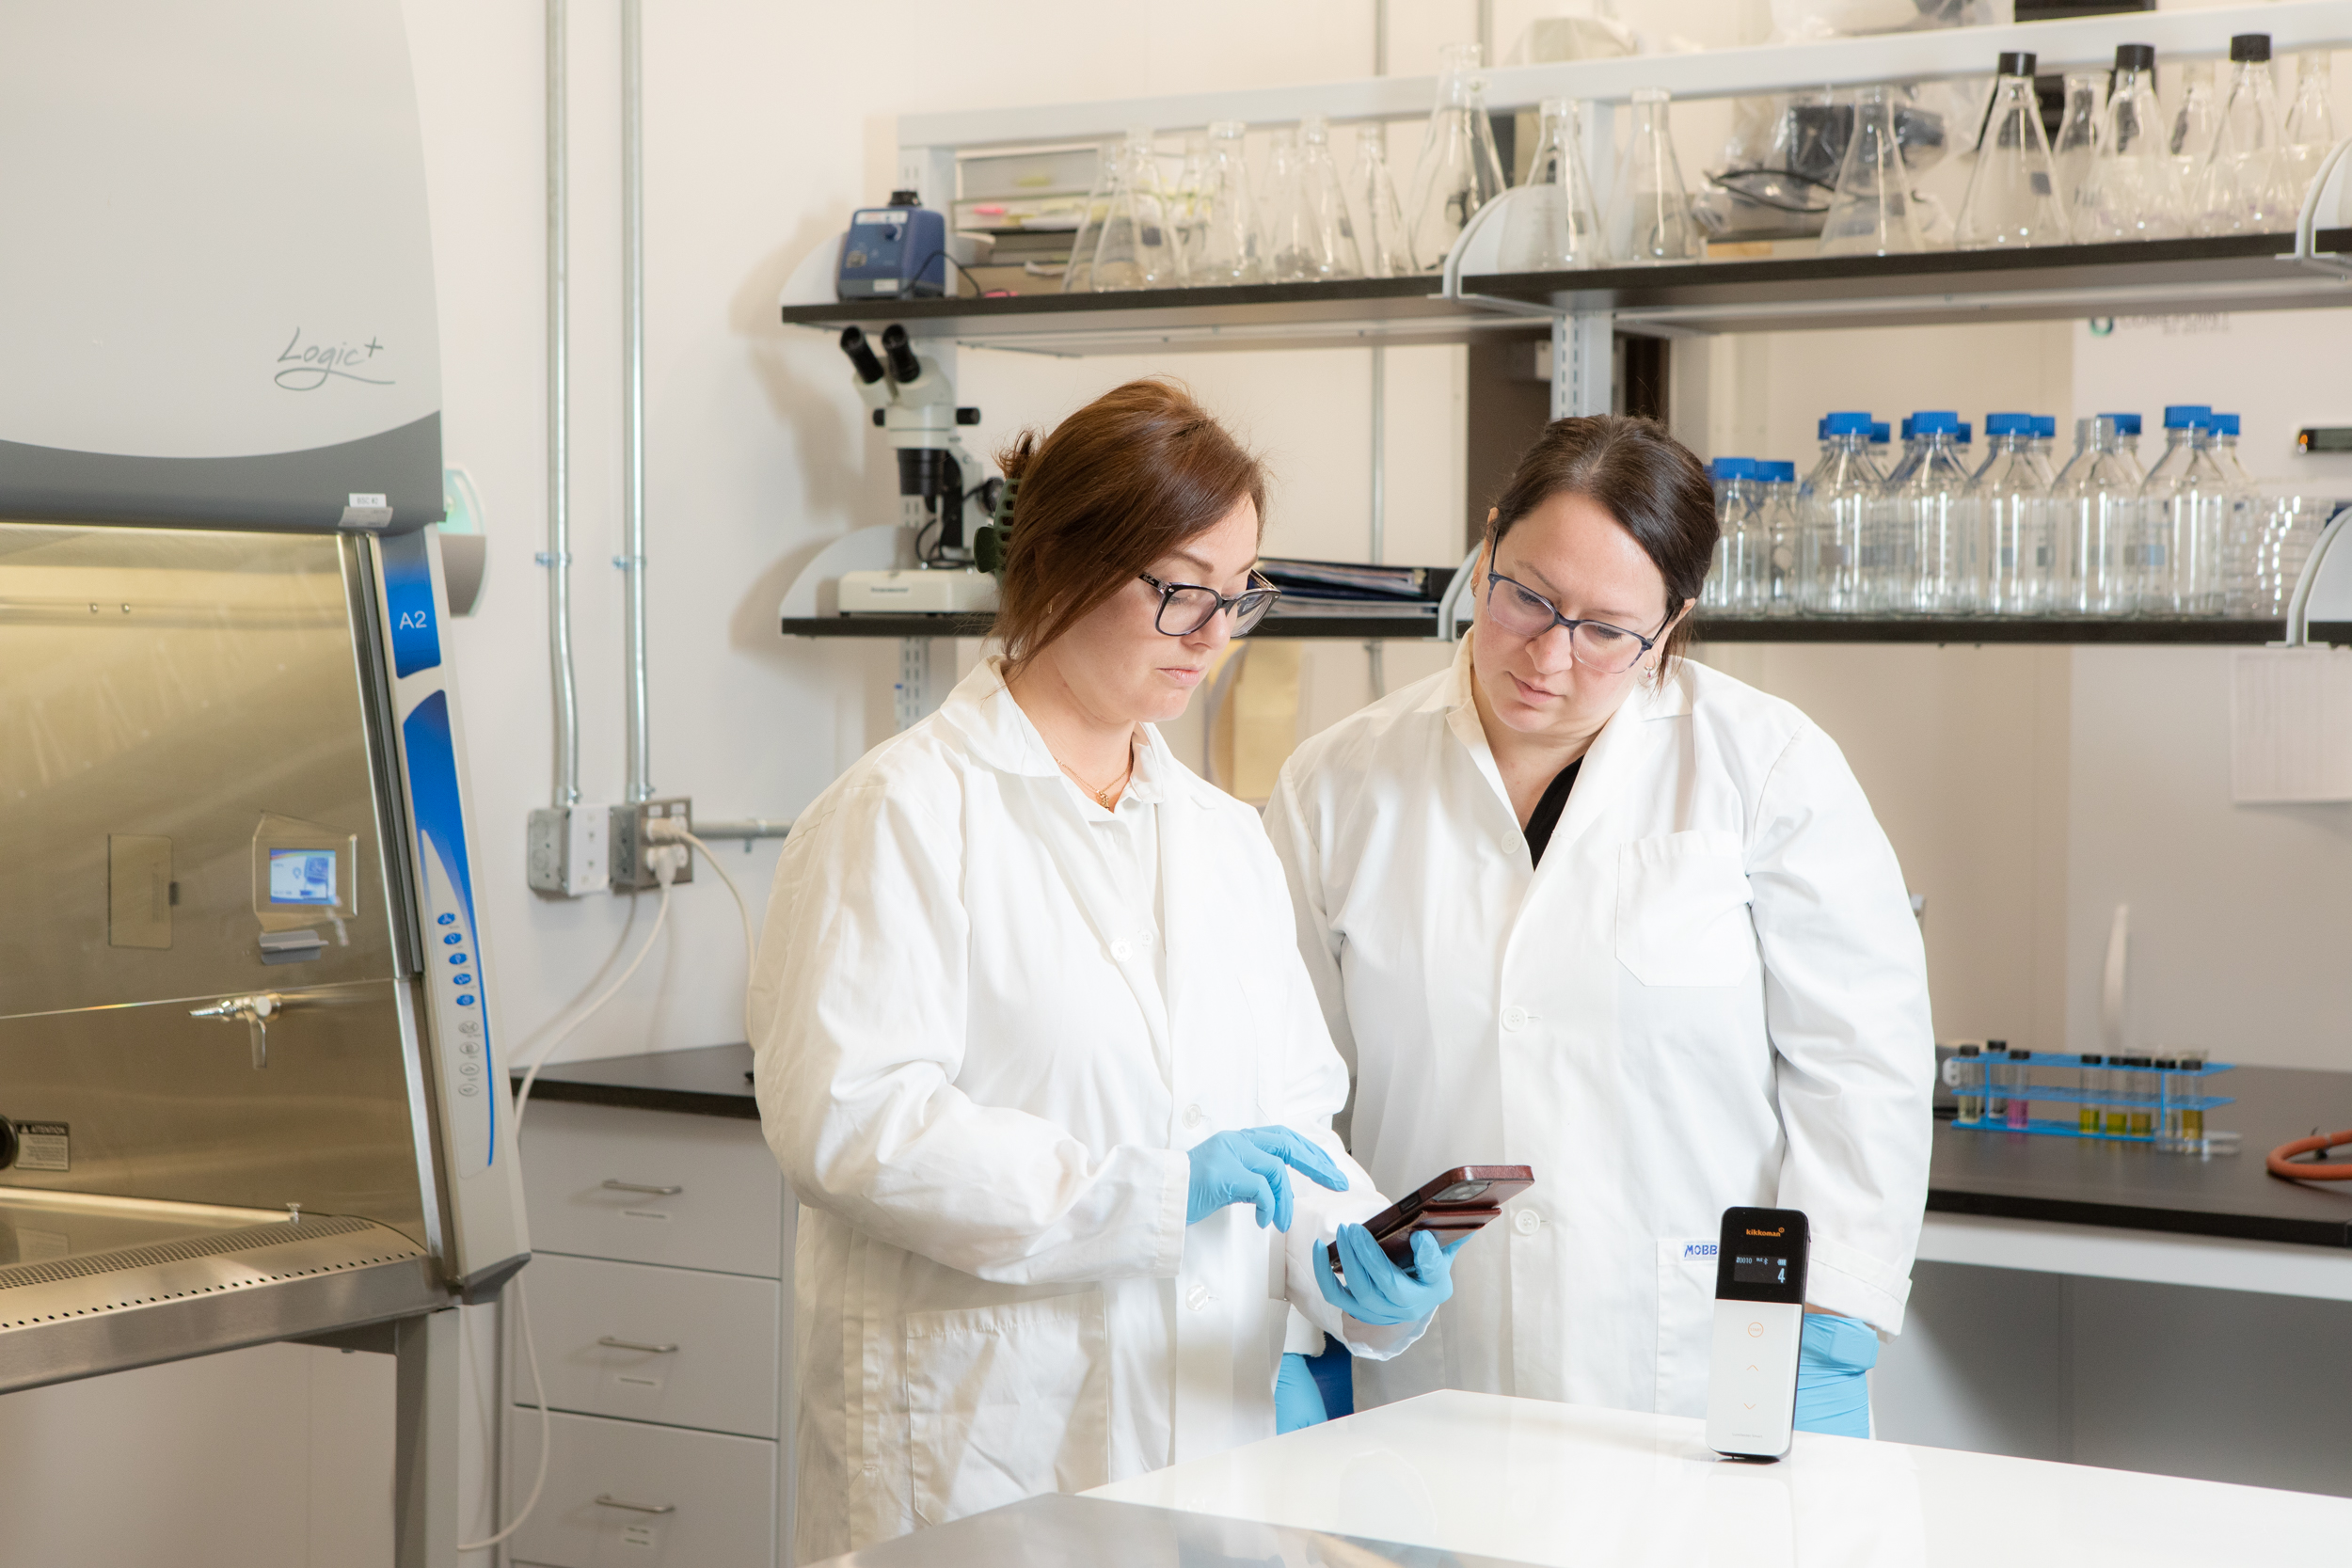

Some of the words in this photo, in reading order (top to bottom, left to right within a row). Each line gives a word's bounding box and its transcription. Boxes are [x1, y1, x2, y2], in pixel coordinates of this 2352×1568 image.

[399, 610, 427, 630] A2
[1745, 1228, 1781, 1238] kikkoman
[1684, 1244, 1718, 1258] MOBB
[1777, 1267, 1786, 1284] 4
